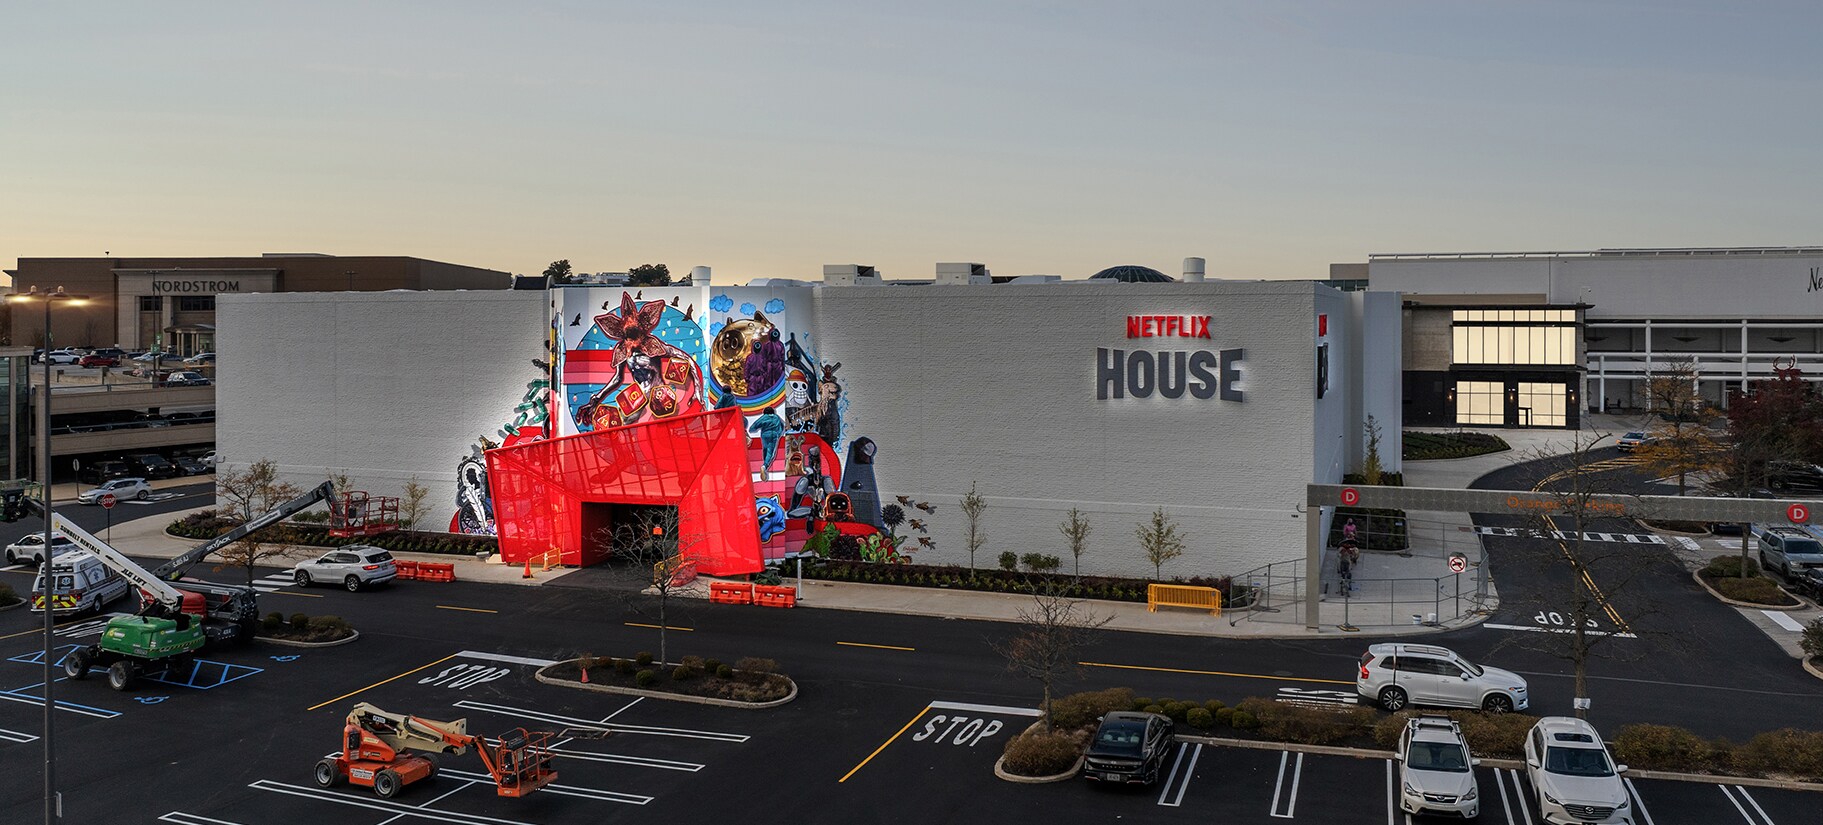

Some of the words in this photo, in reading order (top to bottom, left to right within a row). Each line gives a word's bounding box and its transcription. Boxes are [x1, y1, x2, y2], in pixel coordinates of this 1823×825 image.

[152, 281, 239, 292] NORDSTROM
[1127, 316, 1212, 339] NETFLIX
[1097, 347, 1243, 403] HOUSE
[1345, 492, 1355, 502] D
[1507, 496, 1561, 512] Orange
[1566, 498, 1625, 515] Prking
[1793, 508, 1804, 519] D
[79, 538, 101, 555] RENTALS
[206, 535, 231, 551] SKYJACK
[132, 573, 147, 585] LIFT
[418, 663, 511, 690] STOP
[912, 714, 1004, 747] STOP
